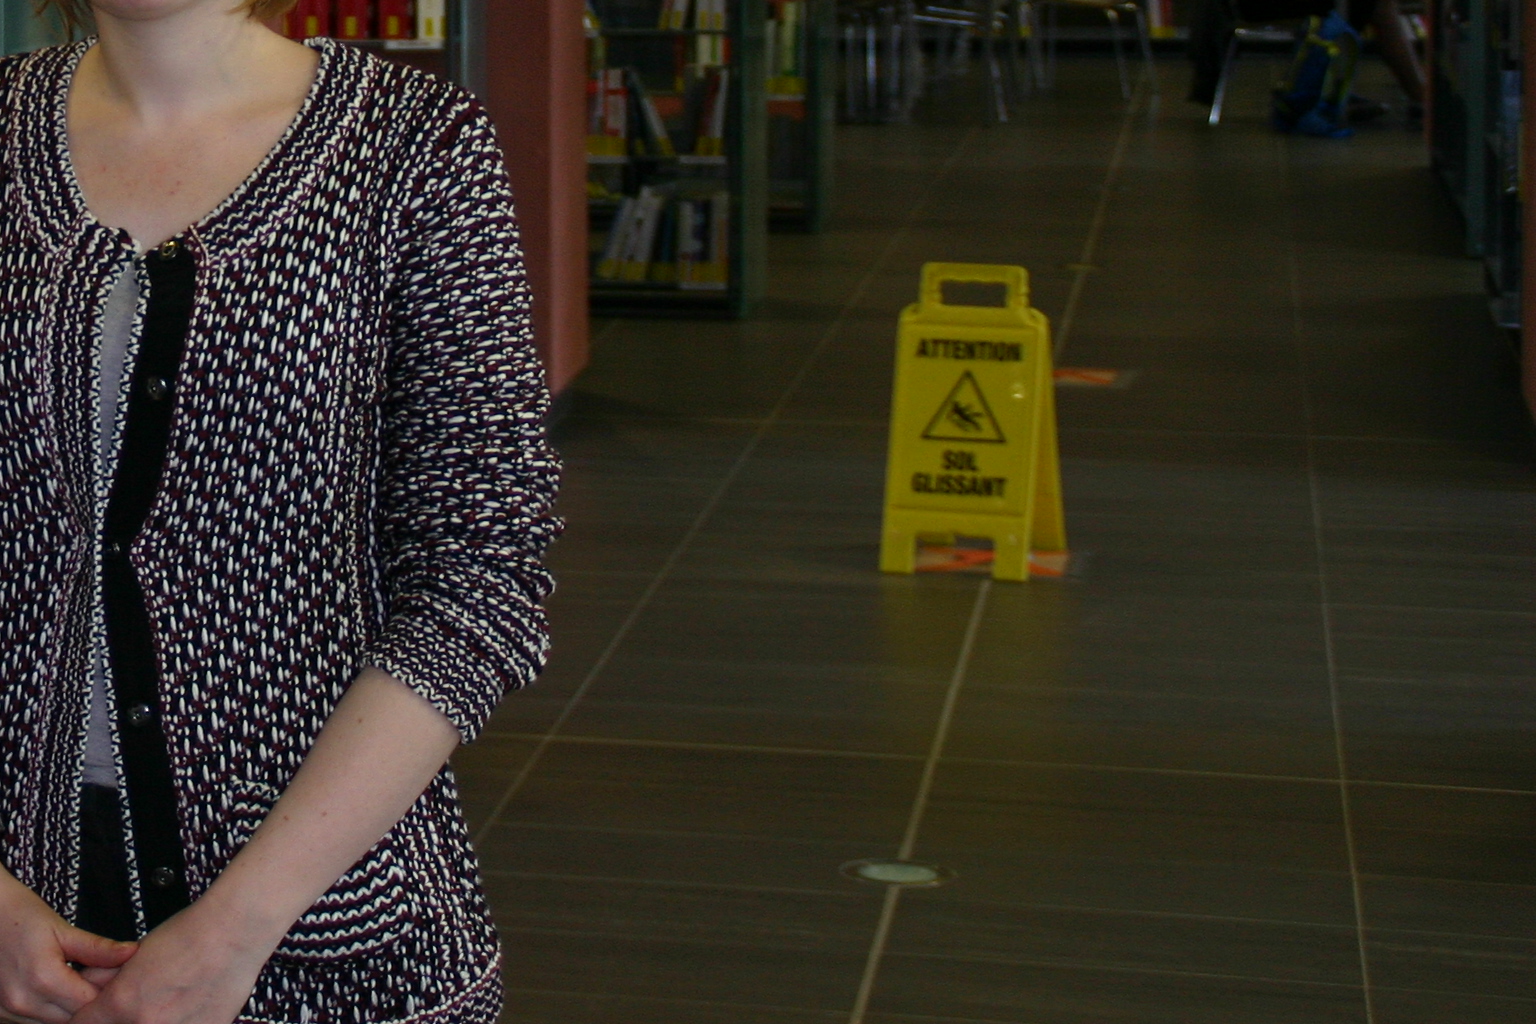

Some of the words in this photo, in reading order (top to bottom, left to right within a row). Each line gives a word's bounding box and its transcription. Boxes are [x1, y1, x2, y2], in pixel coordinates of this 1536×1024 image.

[916, 338, 1022, 361] ATTENTION
[942, 450, 979, 471] SOL
[912, 472, 1007, 497] GLISSANT
